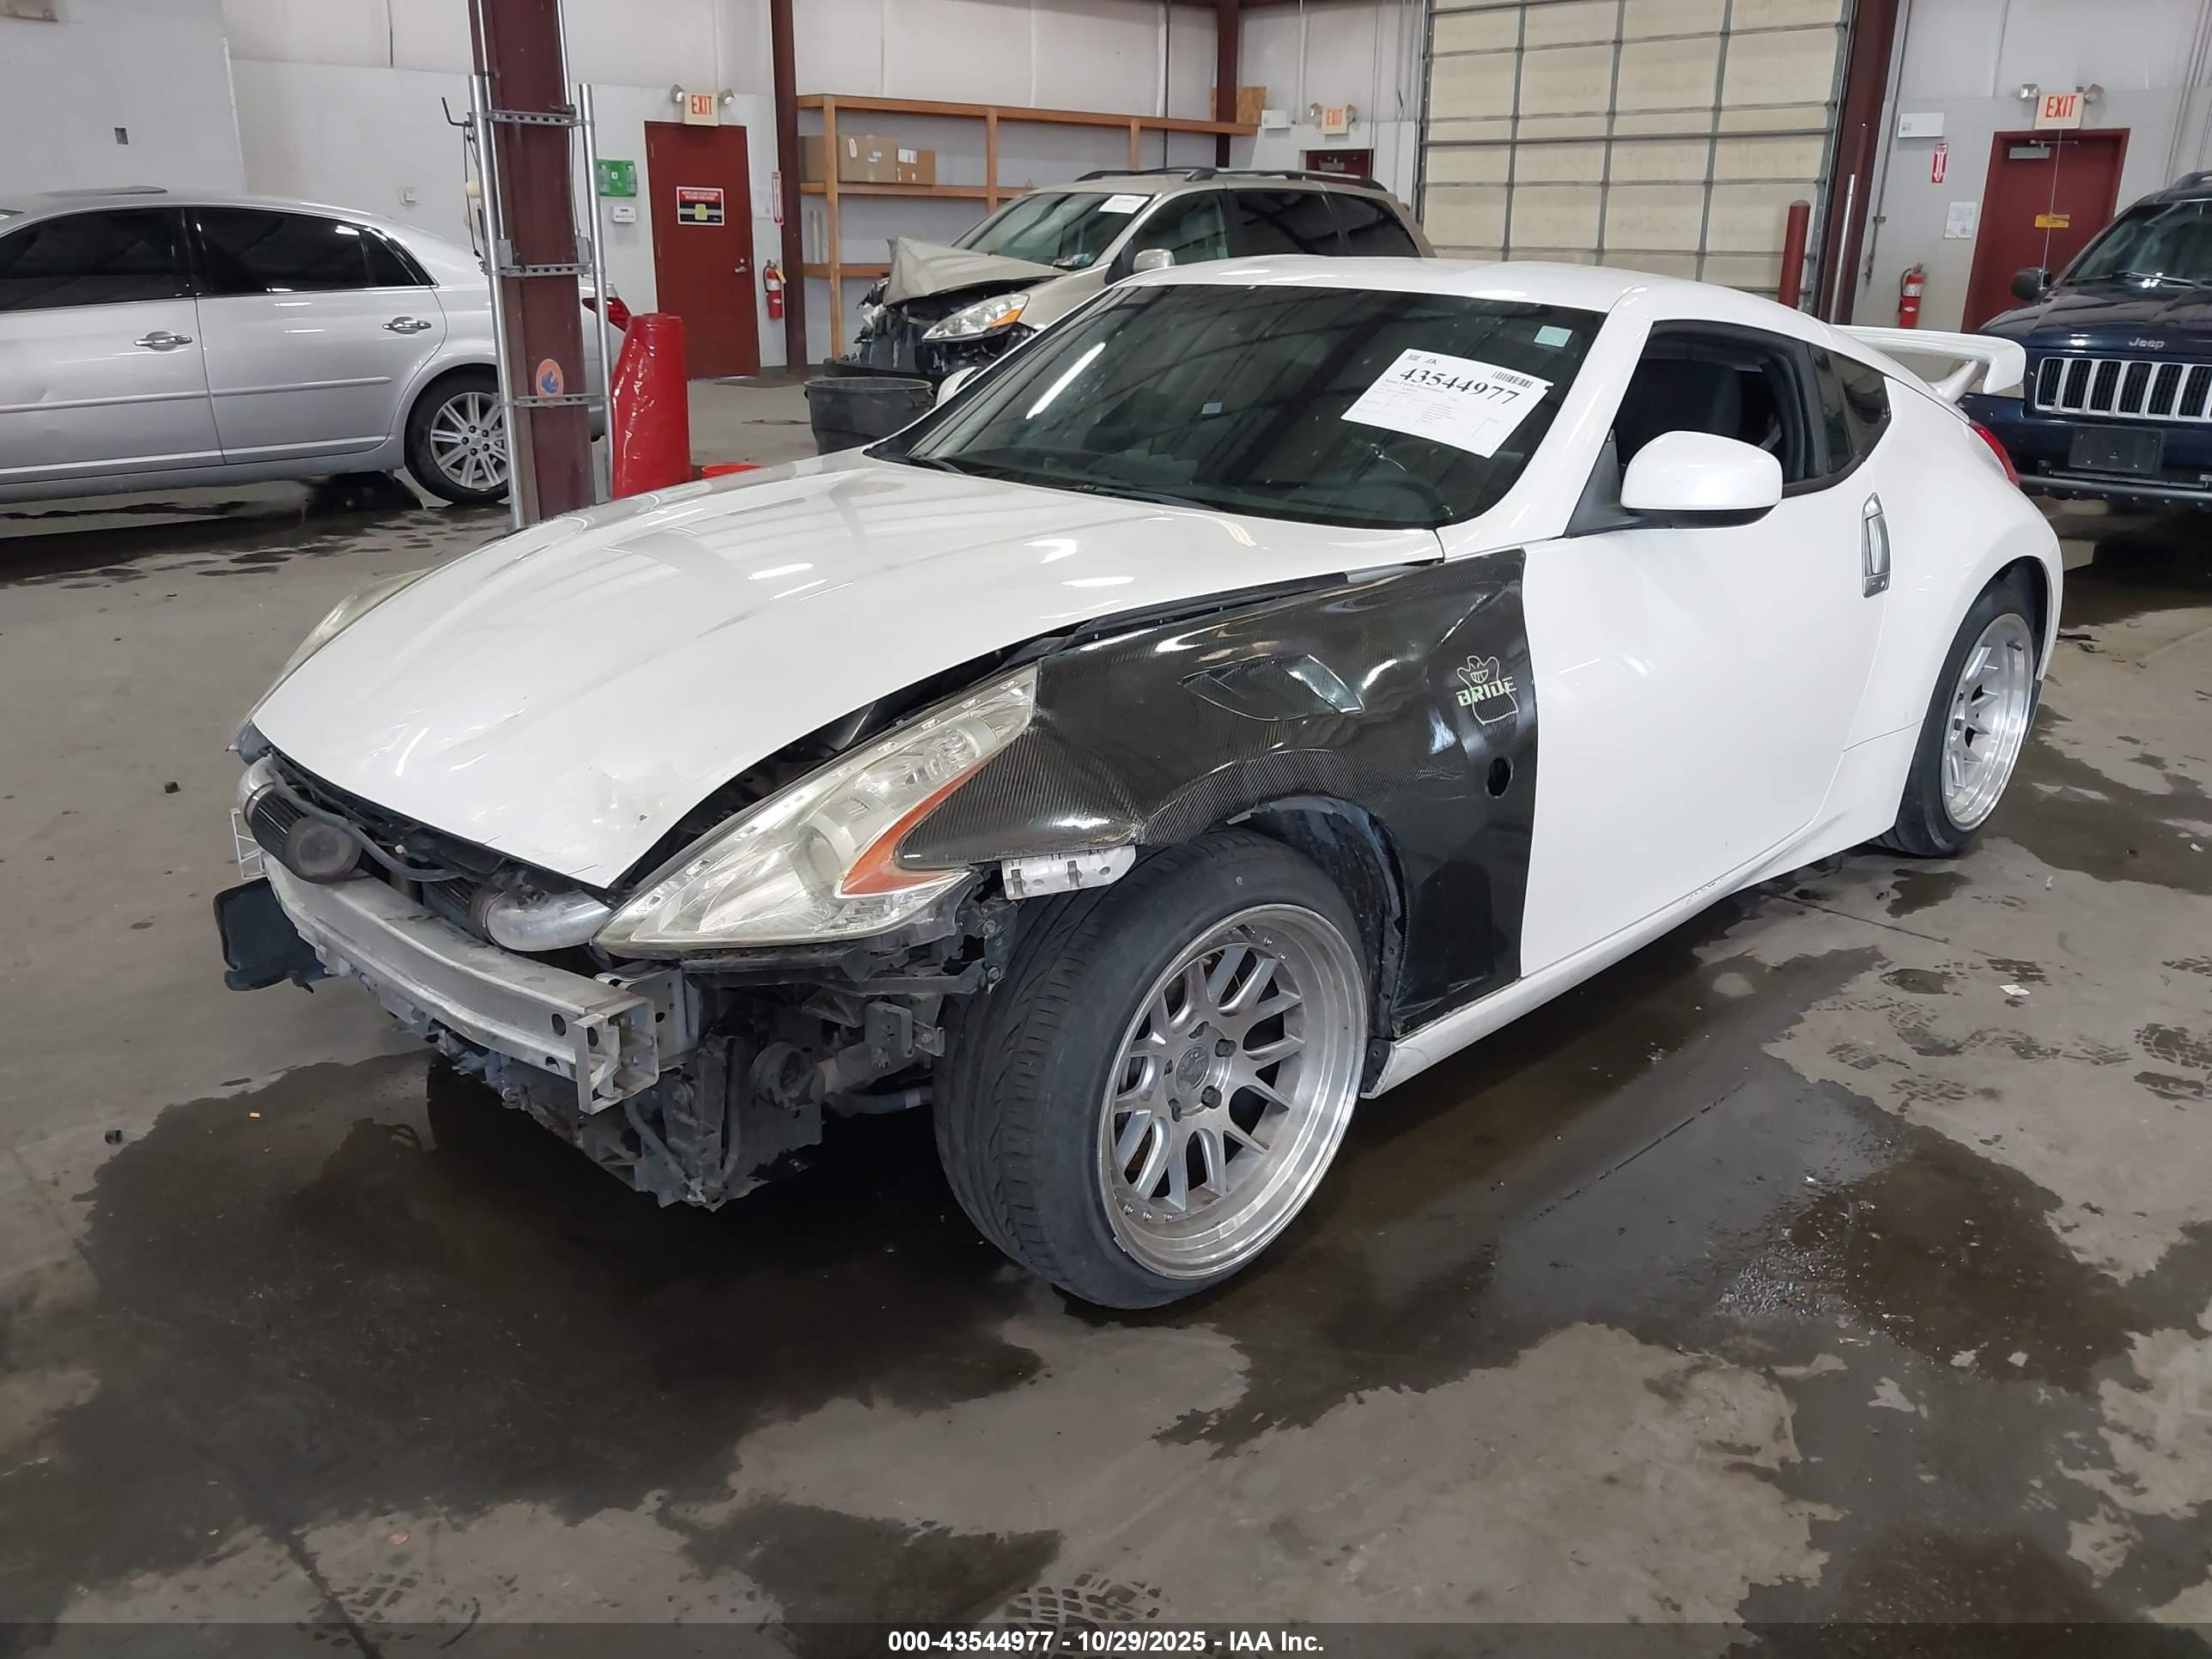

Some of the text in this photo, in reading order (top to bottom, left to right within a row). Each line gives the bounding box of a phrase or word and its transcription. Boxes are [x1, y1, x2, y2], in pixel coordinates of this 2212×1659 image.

[691, 94, 712, 114] EXIT
[2045, 95, 2076, 118] EXIT
[2129, 337, 2165, 349] Jeep
[1399, 368, 1520, 404] 43544977
[1455, 676, 1517, 707] BRIDE
